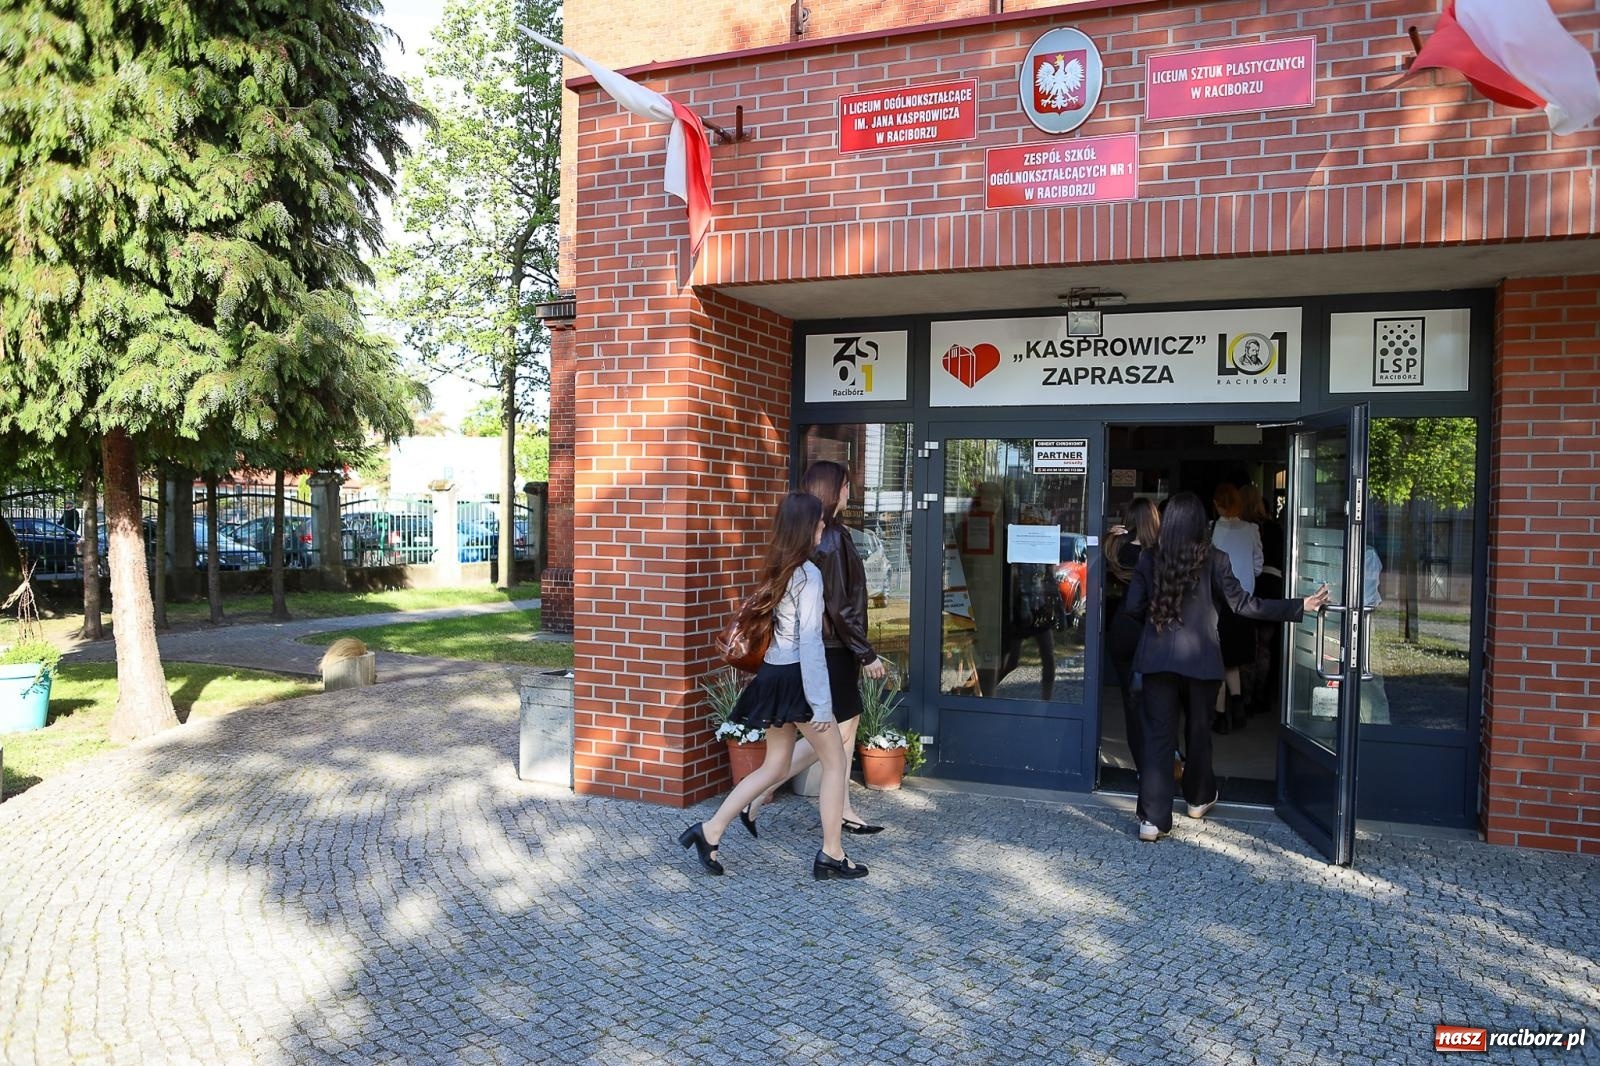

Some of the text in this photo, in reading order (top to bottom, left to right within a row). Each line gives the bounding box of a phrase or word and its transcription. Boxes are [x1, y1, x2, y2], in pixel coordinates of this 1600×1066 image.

[1152, 56, 1305, 84] LICEUM SZTUK PLASTYCZNYCH
[1191, 80, 1264, 99] W RACIBORZU
[849, 100, 881, 115] LICEUM
[884, 88, 972, 110] OGÓLNOKSZTAŁCĄCE
[854, 107, 960, 130] IM. JANA KASPROWICZA
[876, 126, 937, 144] W RACIBORZU
[1023, 145, 1097, 166] ZESPÓŁ SZKÓŁ
[990, 162, 1133, 186] OGÓLNOKSZTAŁCĄCYCH NR 1
[1024, 183, 1096, 200] W RACIBORZU
[1380, 358, 1417, 373] LSP
[1042, 365, 1175, 386] ZAPRASZA
[1217, 377, 1287, 385] RACIBÓRZ
[832, 388, 864, 397] Racibórz
[1037, 451, 1083, 459] PARTNER
